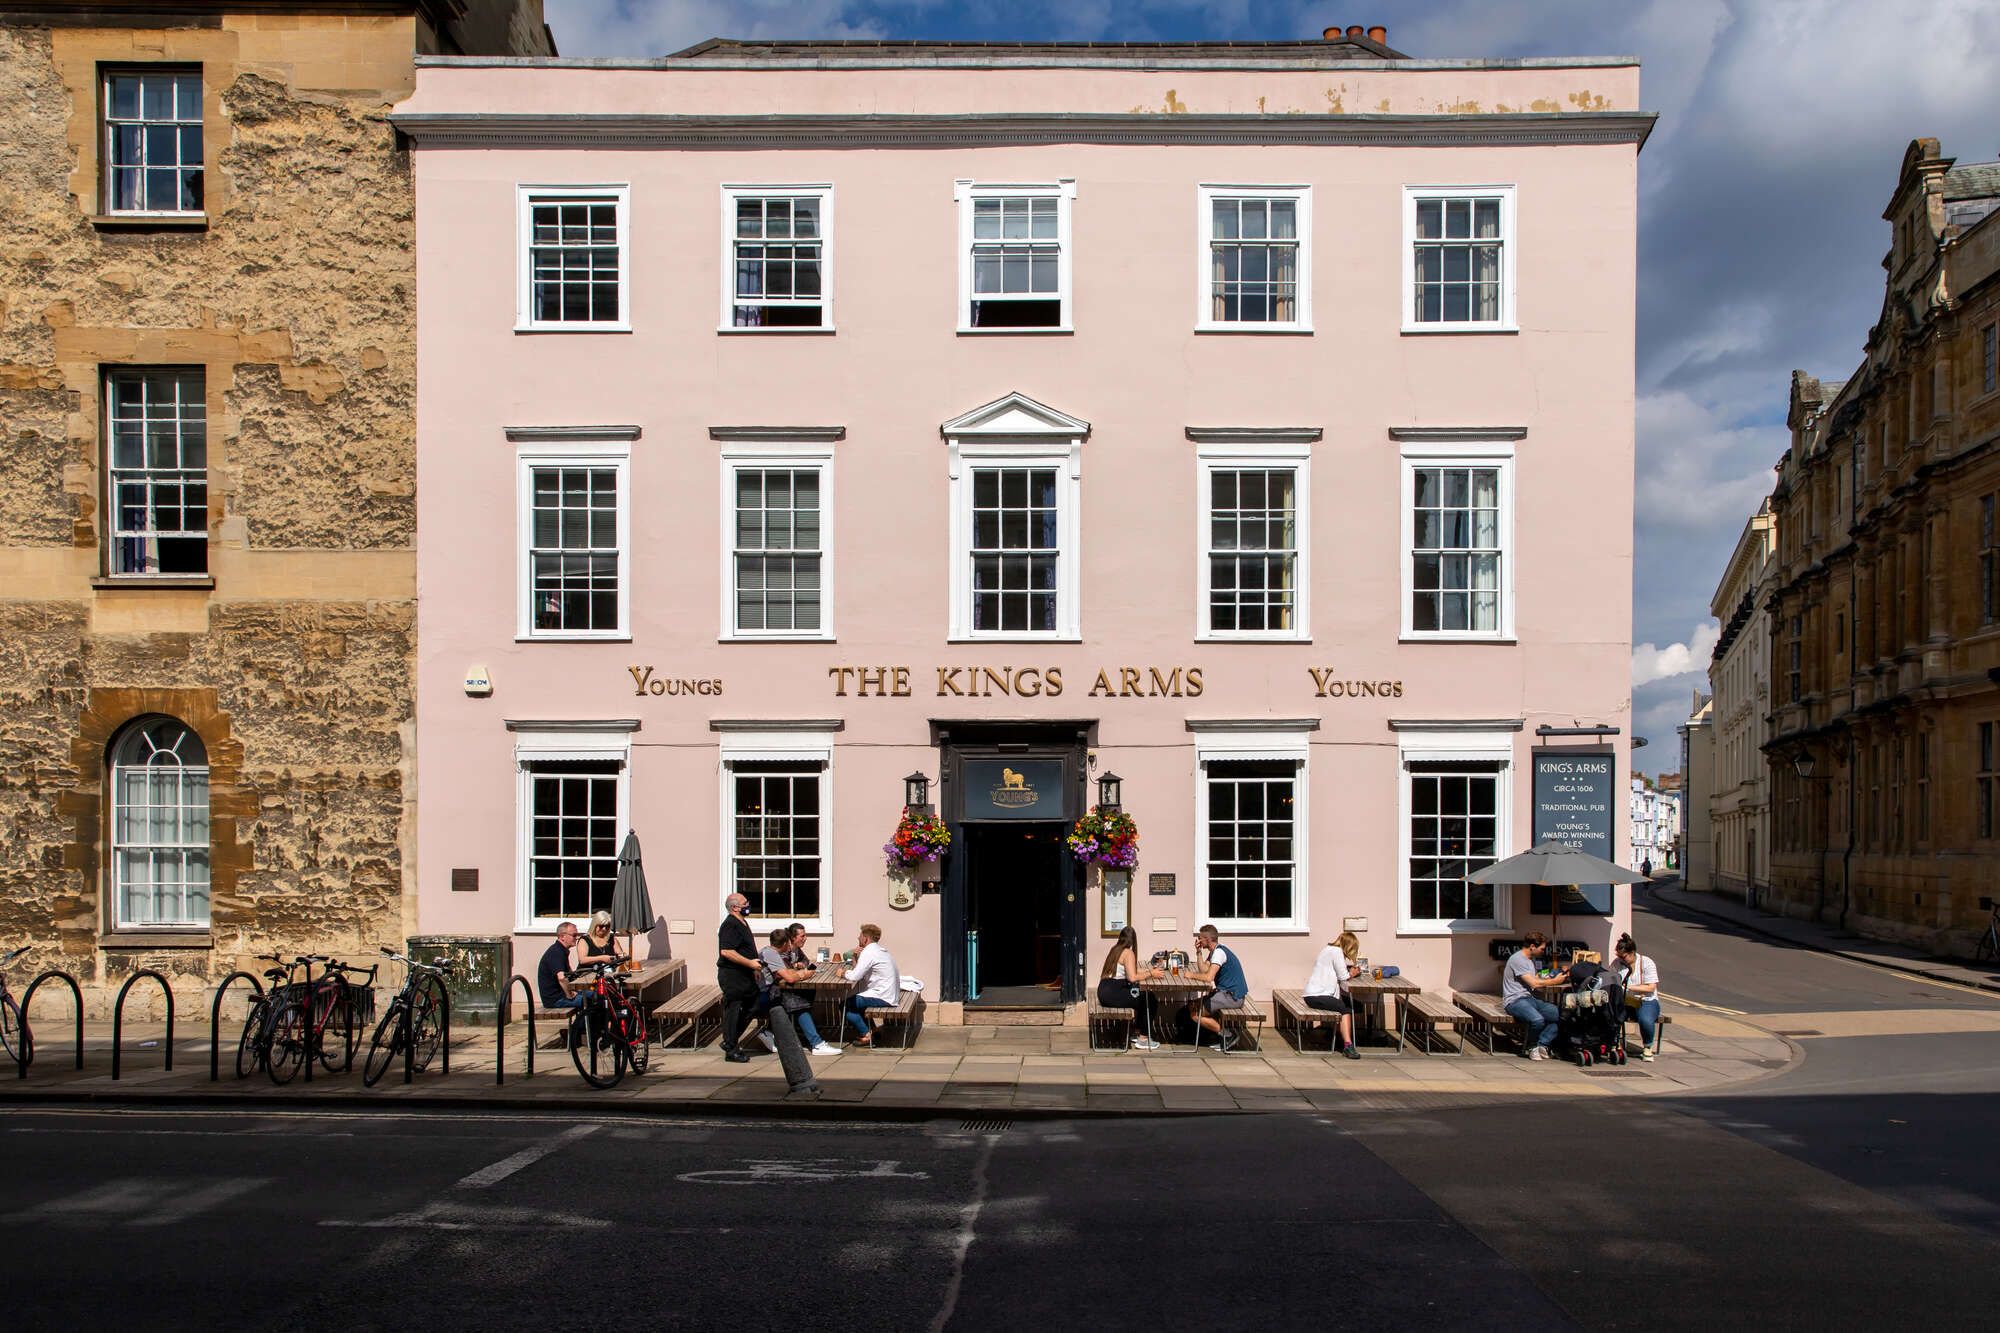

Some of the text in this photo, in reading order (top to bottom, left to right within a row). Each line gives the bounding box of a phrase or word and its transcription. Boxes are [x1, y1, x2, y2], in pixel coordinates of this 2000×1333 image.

[829, 666, 1204, 698] THE KINGS ARMS
[1575, 764, 1607, 773] ARMS
[1563, 840, 1583, 848] ALES
